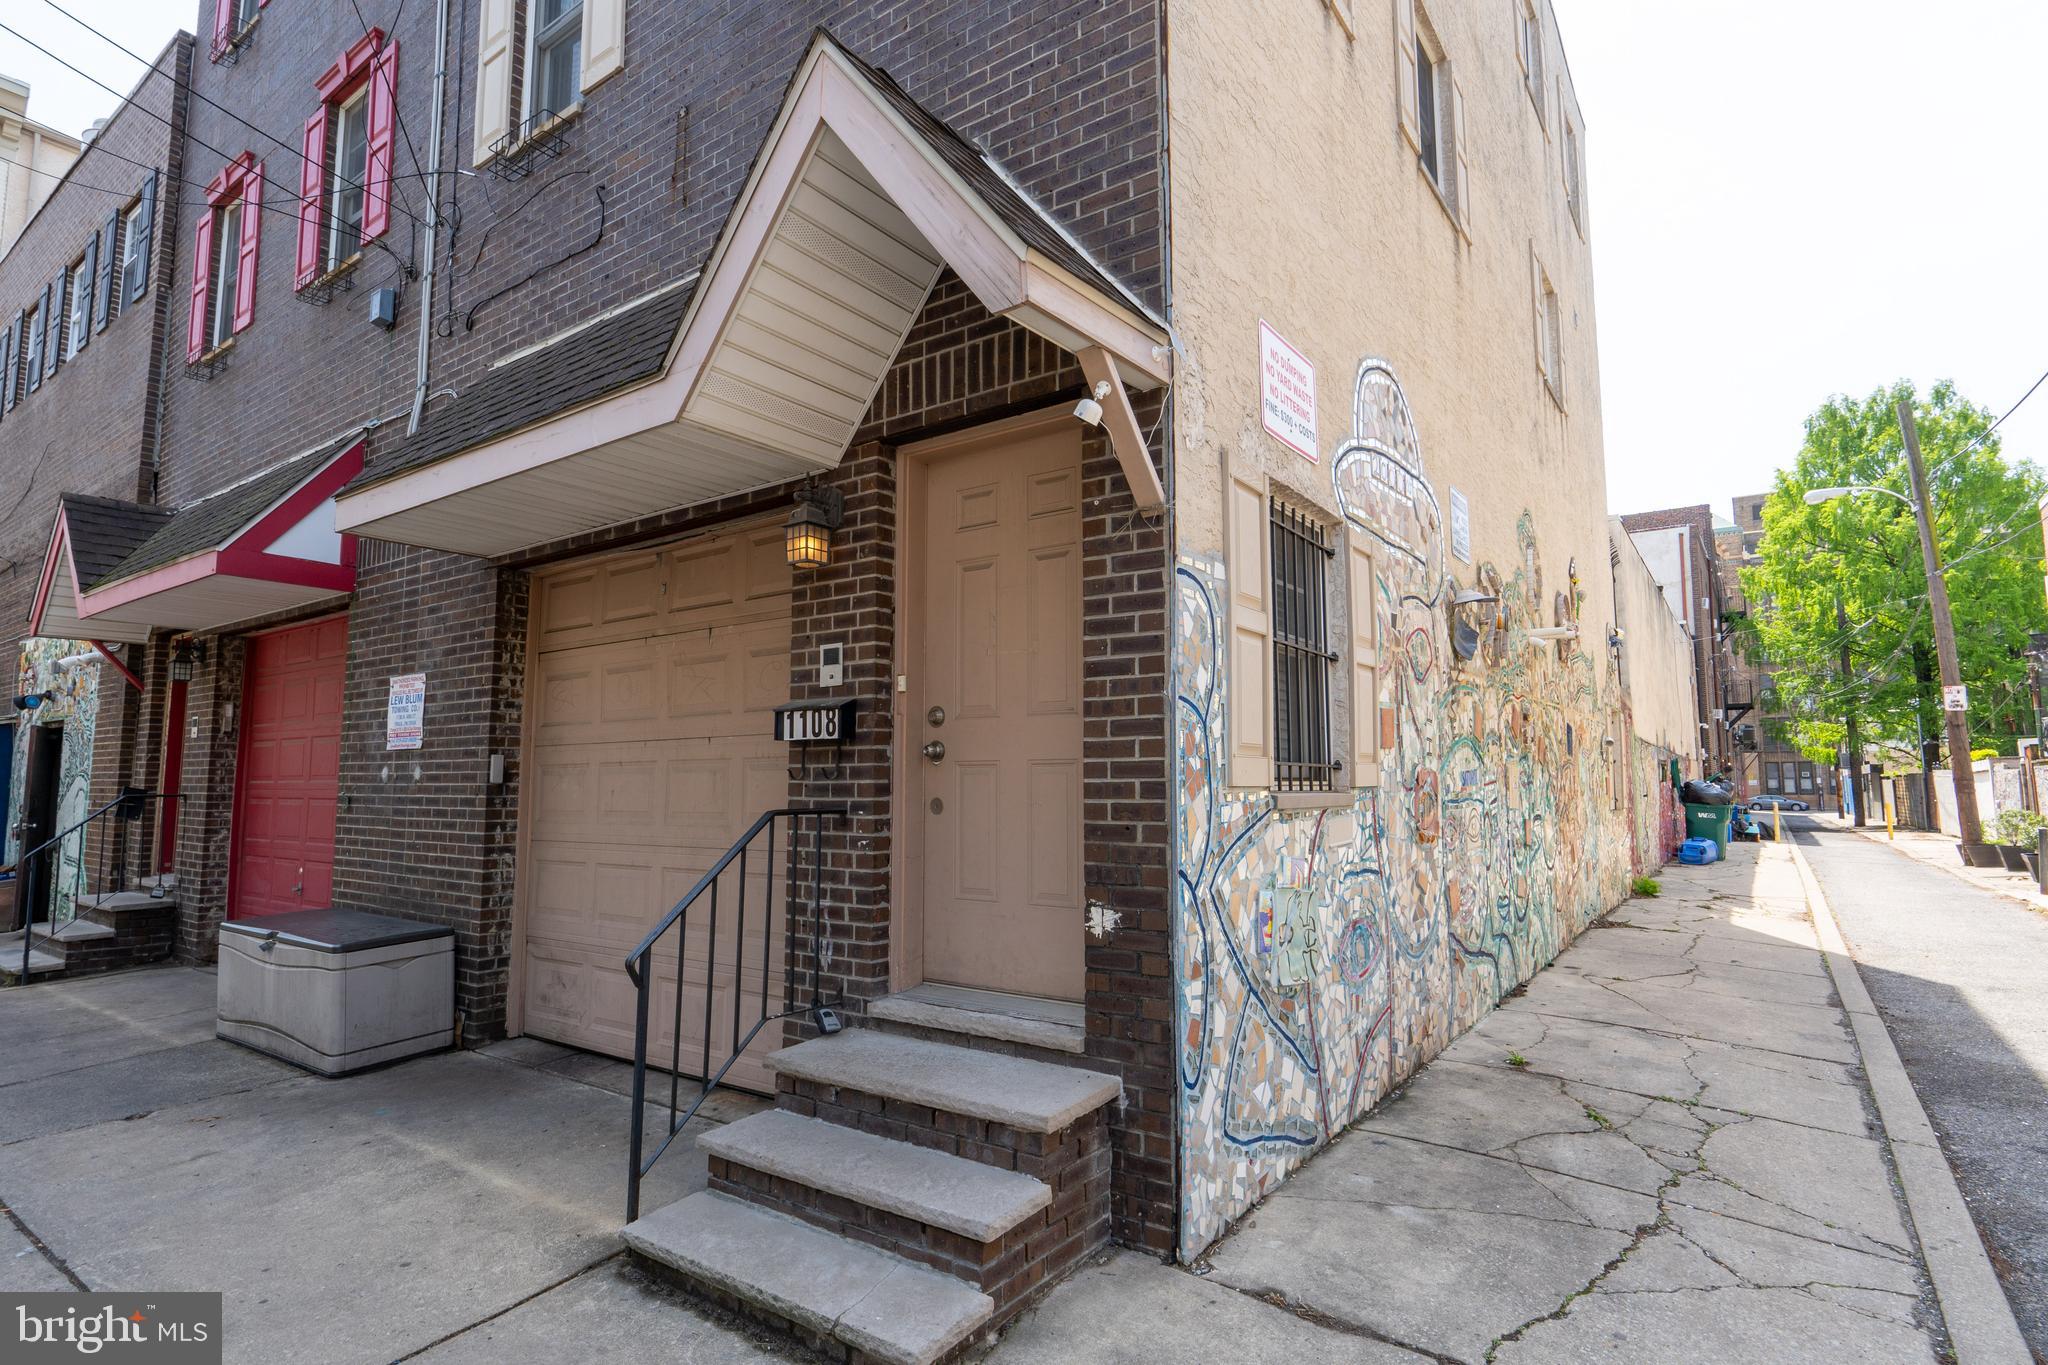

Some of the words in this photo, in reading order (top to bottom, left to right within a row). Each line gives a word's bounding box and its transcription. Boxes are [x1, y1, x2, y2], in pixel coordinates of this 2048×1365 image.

[1266, 360, 1275, 377] NO
[1276, 368, 1292, 391] YARD
[1293, 382, 1313, 408] WASTE
[1270, 347, 1279, 364] NO
[1280, 355, 1307, 386] DUMPING
[1265, 398, 1280, 417] FINE:
[1298, 423, 1316, 443] COSTS
[1269, 383, 1279, 399] NO
[1280, 391, 1311, 423] LITTERING
[391, 695, 405, 705] LEW
[405, 693, 423, 704] BLUM
[391, 705, 409, 714] TOWING
[786, 709, 837, 739] 1108
